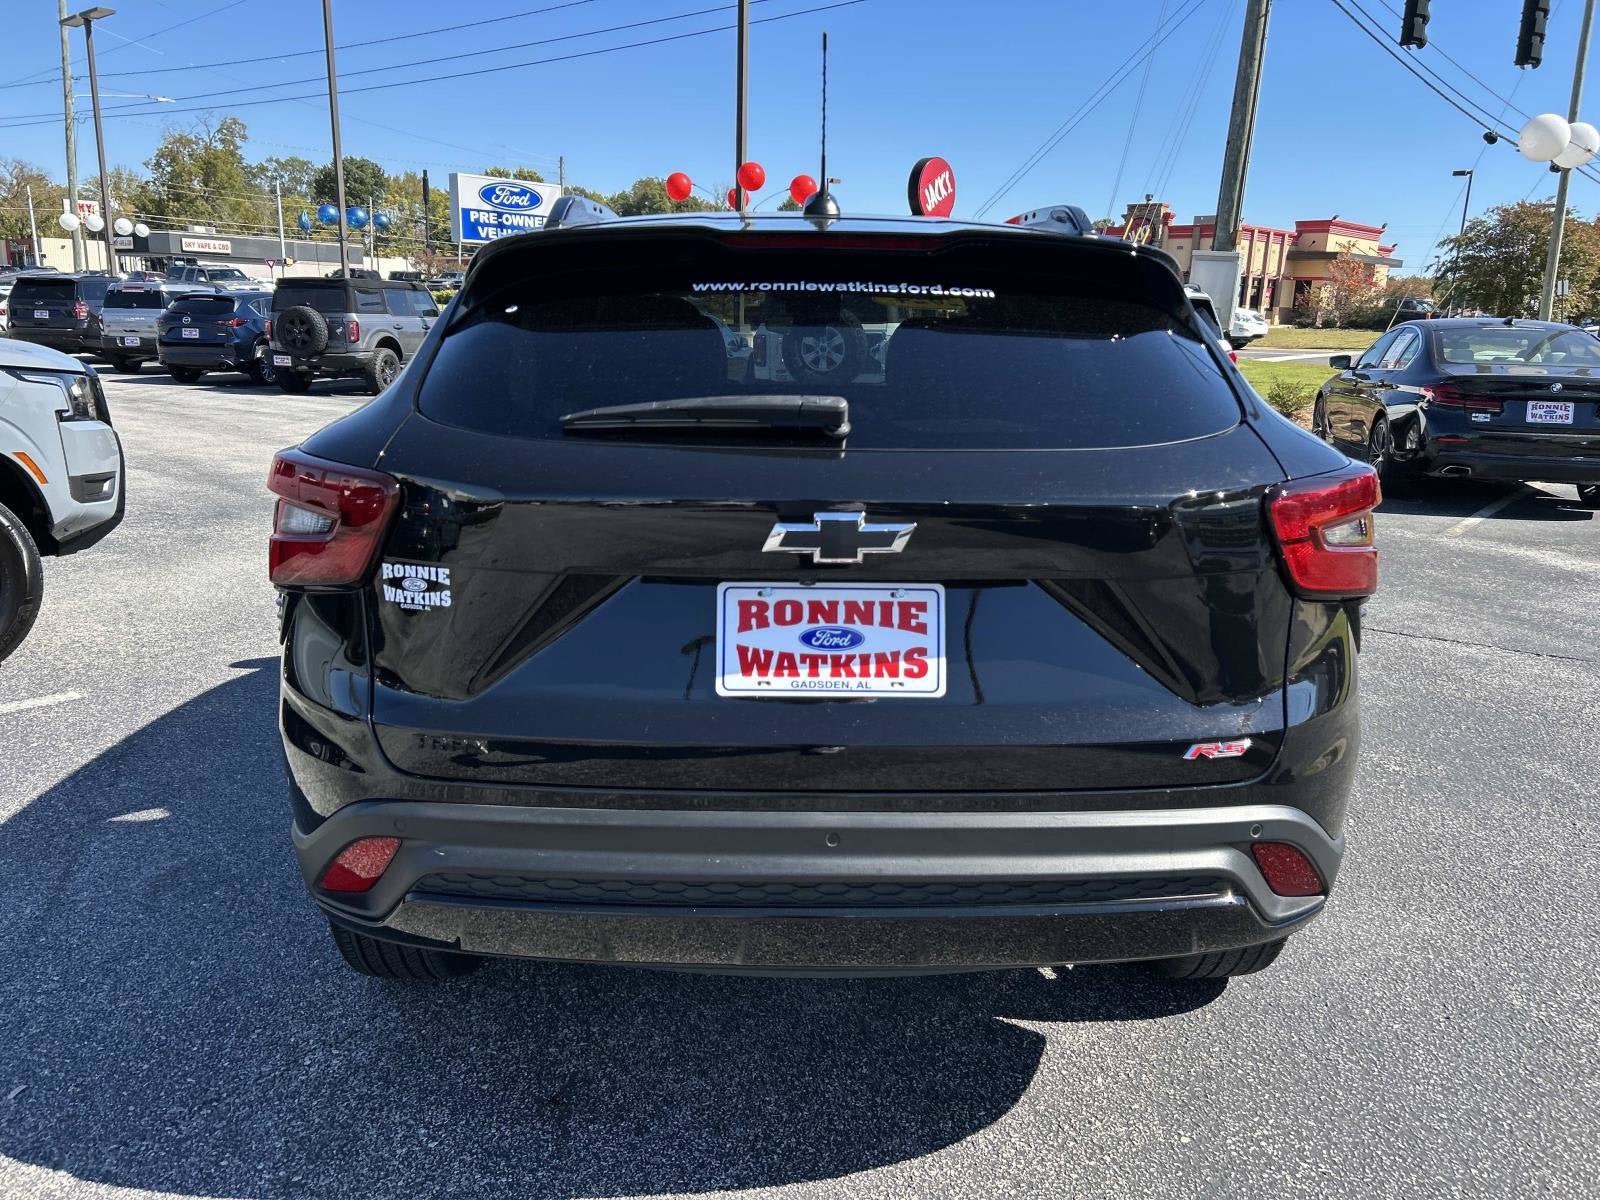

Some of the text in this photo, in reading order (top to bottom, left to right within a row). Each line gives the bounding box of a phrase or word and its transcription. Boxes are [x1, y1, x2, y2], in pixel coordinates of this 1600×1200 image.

[491, 185, 530, 205] Ford
[477, 225, 518, 239] VEH
[184, 241, 195, 249] SKY
[197, 241, 212, 250] VAPE
[218, 243, 230, 251] CBD
[691, 280, 996, 298] www.ronniewatkinsford.com
[1530, 412, 1570, 421] WATKINS
[1531, 403, 1570, 413] RONNIE
[381, 562, 450, 586] RONNIE
[383, 584, 452, 607] WATKINS
[737, 599, 928, 636] RONNIE
[810, 628, 853, 647] Ford
[736, 643, 929, 679] WATKINS
[790, 680, 872, 690] GADSDEN, AL
[1183, 738, 1252, 760] RS
